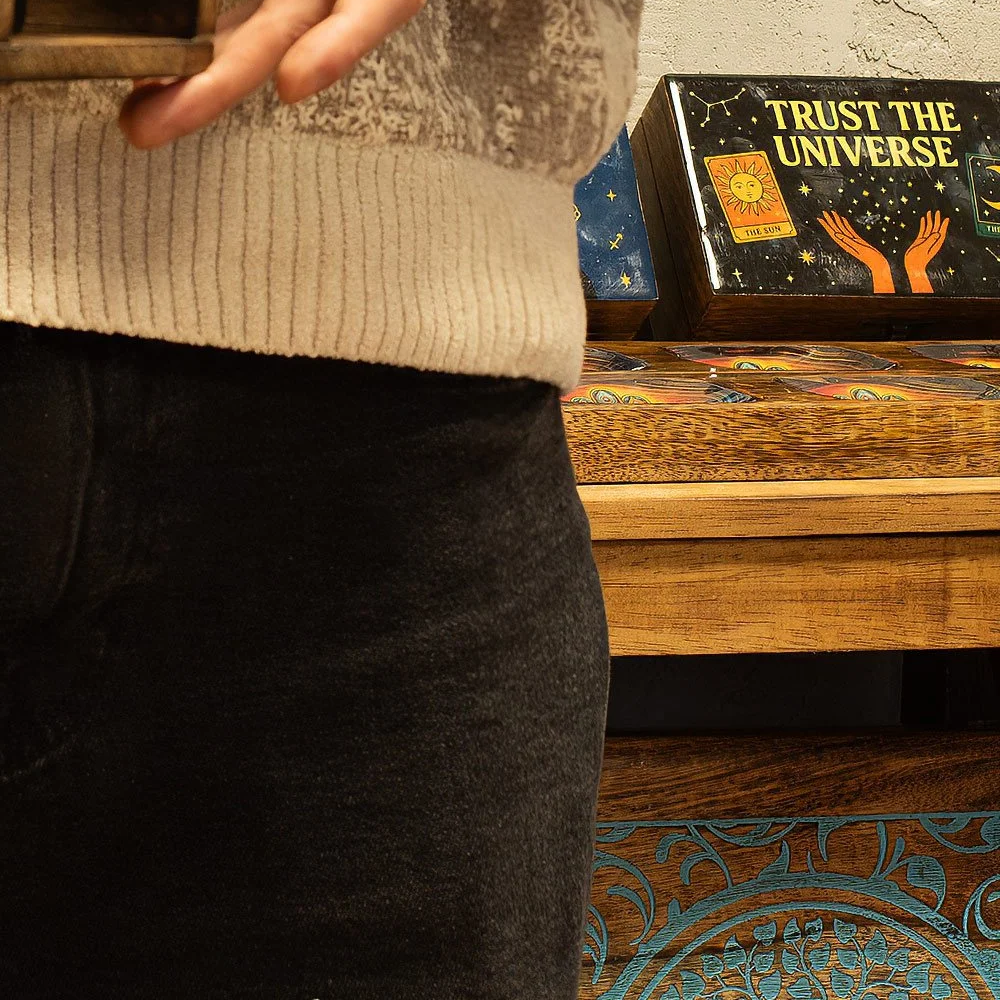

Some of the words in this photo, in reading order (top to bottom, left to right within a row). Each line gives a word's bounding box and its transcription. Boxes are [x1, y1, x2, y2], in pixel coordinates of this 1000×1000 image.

[765, 100, 881, 131] TRUST
[889, 101, 961, 132] THE
[773, 135, 959, 168] UNIVERSE
[745, 228, 762, 236] THE
[763, 225, 781, 234] SUN
